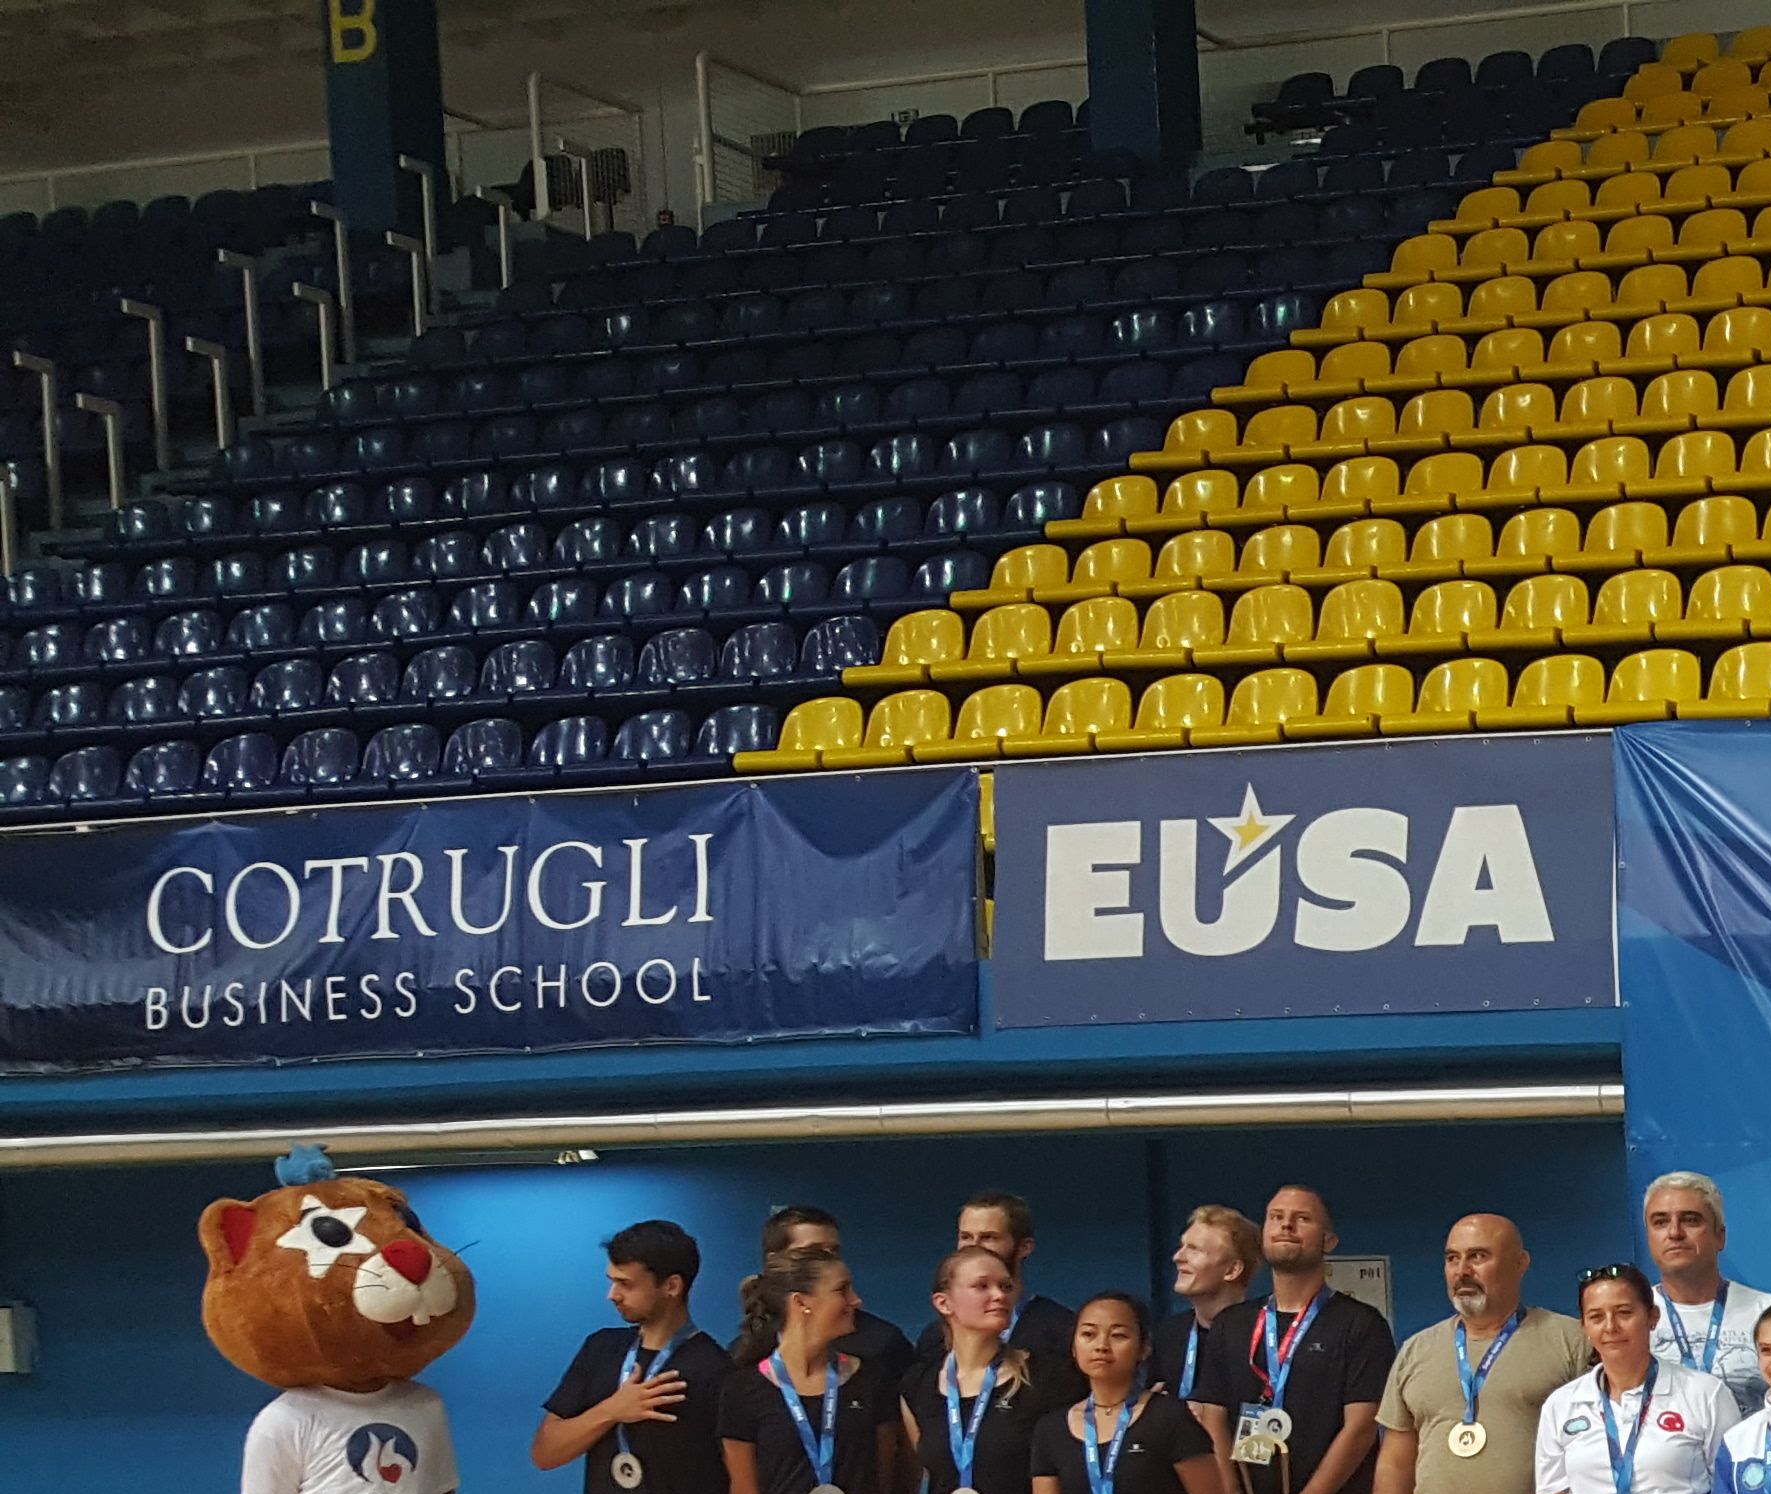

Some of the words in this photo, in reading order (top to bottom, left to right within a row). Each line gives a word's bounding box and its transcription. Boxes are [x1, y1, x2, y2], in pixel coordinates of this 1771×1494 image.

[146, 832, 715, 955] COTRUGLI
[1044, 786, 1555, 961] EUSA
[145, 972, 418, 1030] BUSINESS
[453, 957, 713, 1015] SCHOOL
